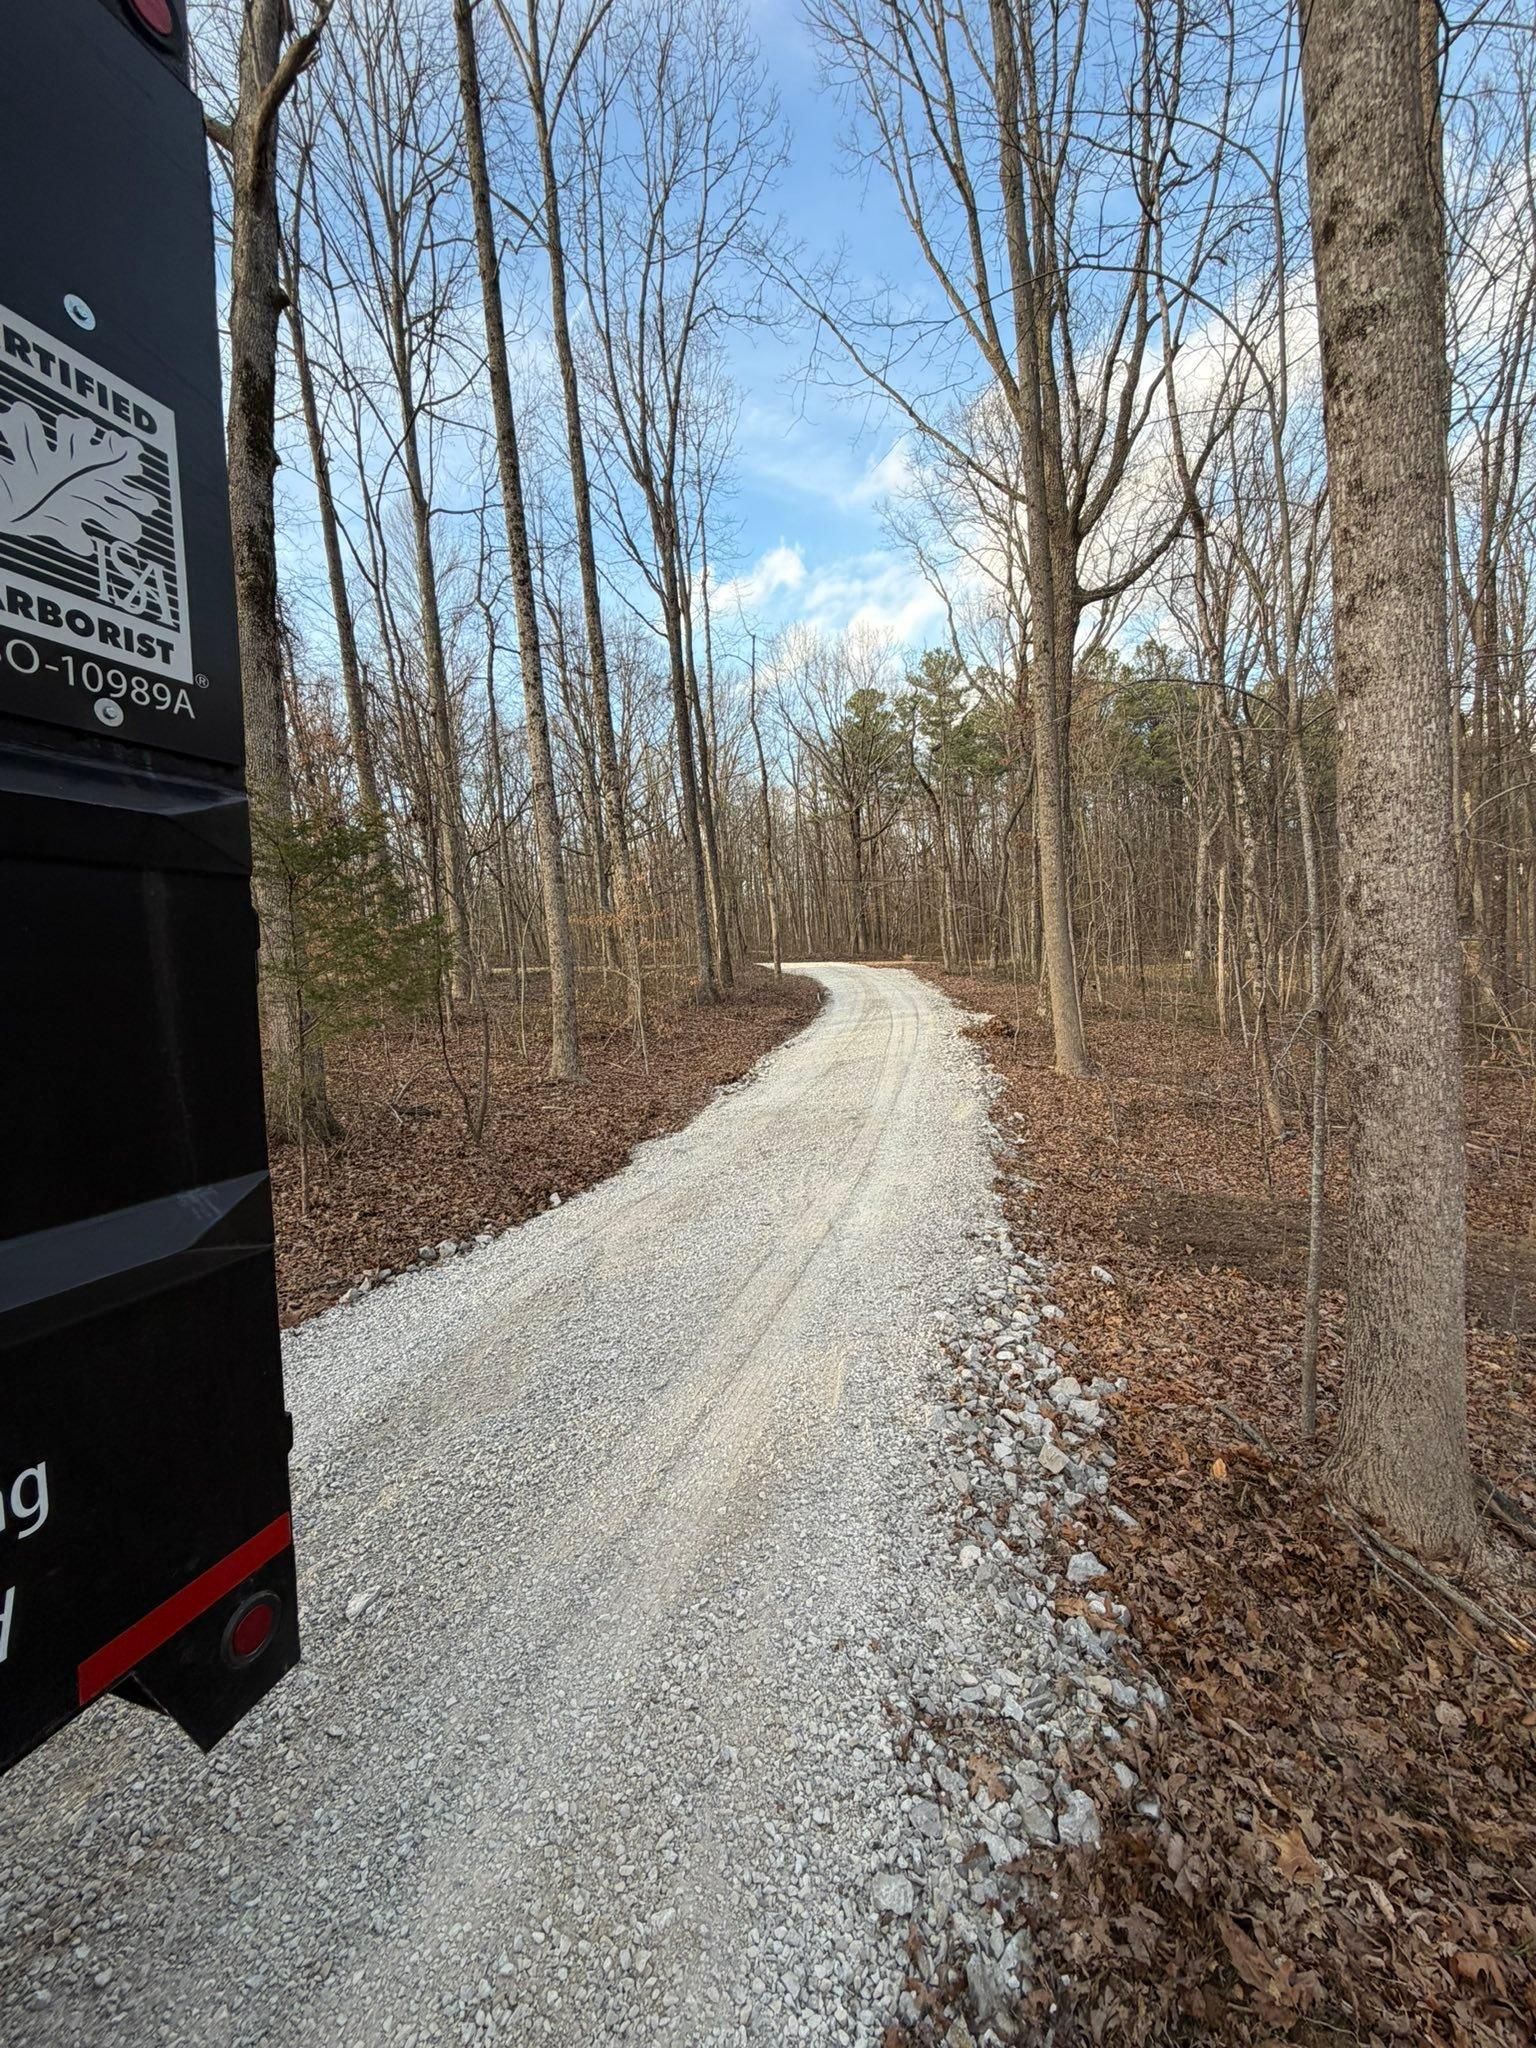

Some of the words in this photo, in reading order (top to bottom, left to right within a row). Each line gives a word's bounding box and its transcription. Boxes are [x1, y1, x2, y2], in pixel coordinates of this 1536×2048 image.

[2, 324, 157, 435] RTIFIED
[0, 585, 175, 665] RBORIST
[91, 535, 178, 628] ISA
[0, 638, 196, 719] O-10989A
